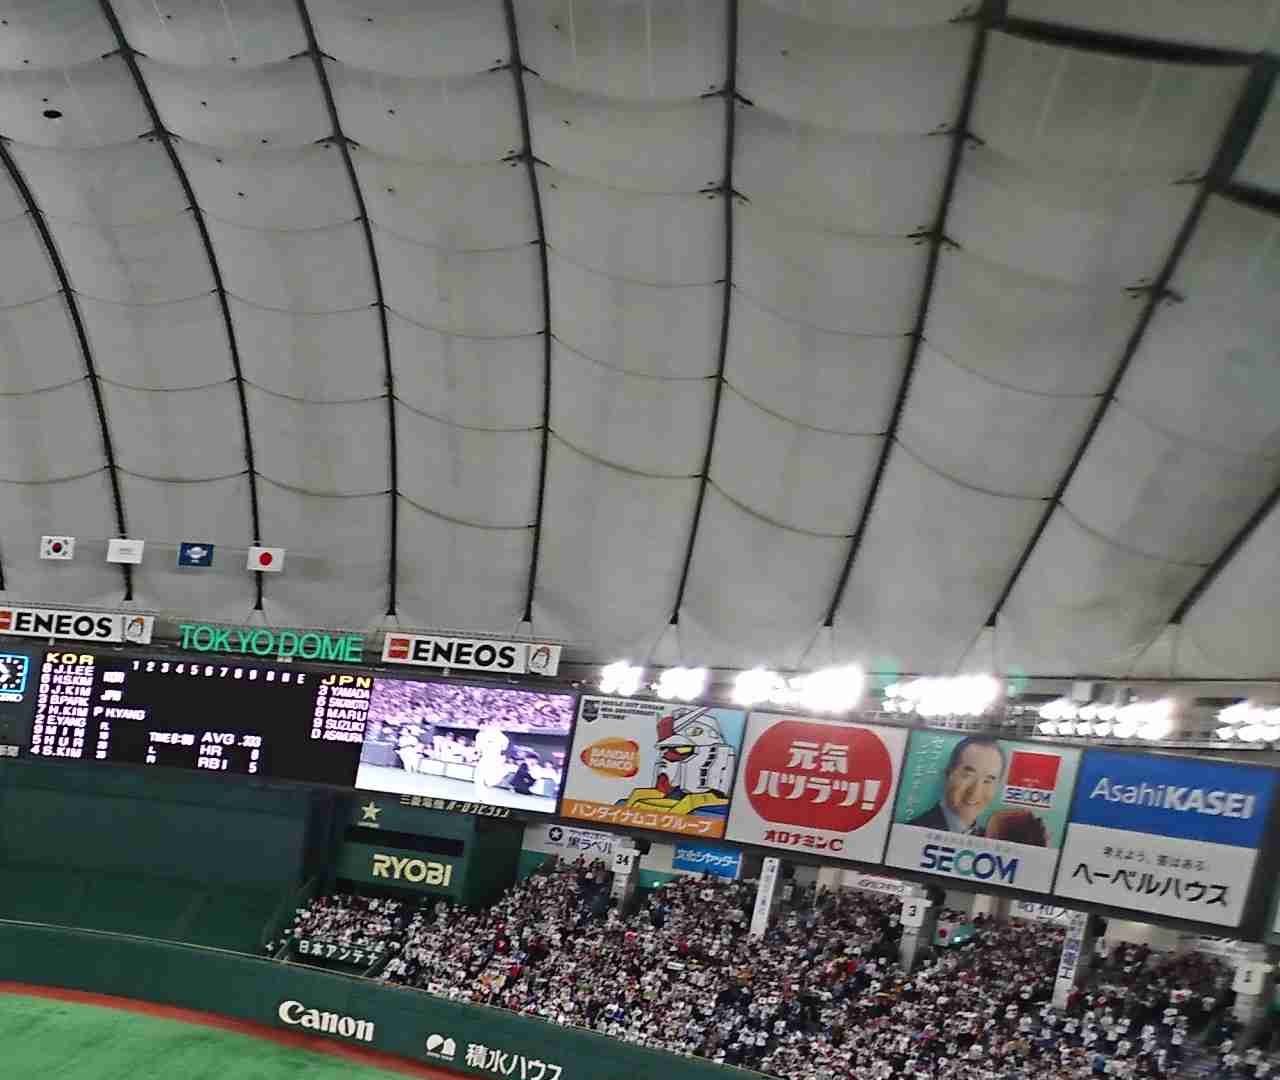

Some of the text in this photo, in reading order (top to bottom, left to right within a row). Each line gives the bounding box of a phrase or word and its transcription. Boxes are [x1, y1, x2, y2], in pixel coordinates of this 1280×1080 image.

[14, 612, 113, 640] ENEOS
[178, 623, 364, 664] TOKYO DOME
[46, 652, 95, 665] KOR
[411, 638, 516, 669] ENEOS
[53, 664, 96, 676] J.LEE
[321, 674, 373, 689] JPN
[50, 685, 91, 697] J.KIM
[330, 686, 370, 700] YAMADA
[326, 708, 368, 722] MARU
[324, 718, 366, 733] SUZUKI
[201, 731, 236, 746] AVG
[41, 745, 83, 759] S.KIM
[199, 744, 223, 758] HR
[786, 740, 850, 775] 元気
[197, 756, 229, 770] RBI
[1004, 787, 1053, 804] SECOM
[1089, 776, 1258, 820] AsahiKASEI
[570, 802, 714, 834] バンダイナムコグループ
[567, 836, 614, 855] 黒ラベル
[763, 829, 845, 852] オロナミンC
[615, 853, 630, 866] 34
[919, 843, 1020, 885] SECOM
[371, 853, 453, 887] RYOBI
[1072, 862, 1231, 908] ヘーベルハウス
[277, 999, 376, 1043] Canon
